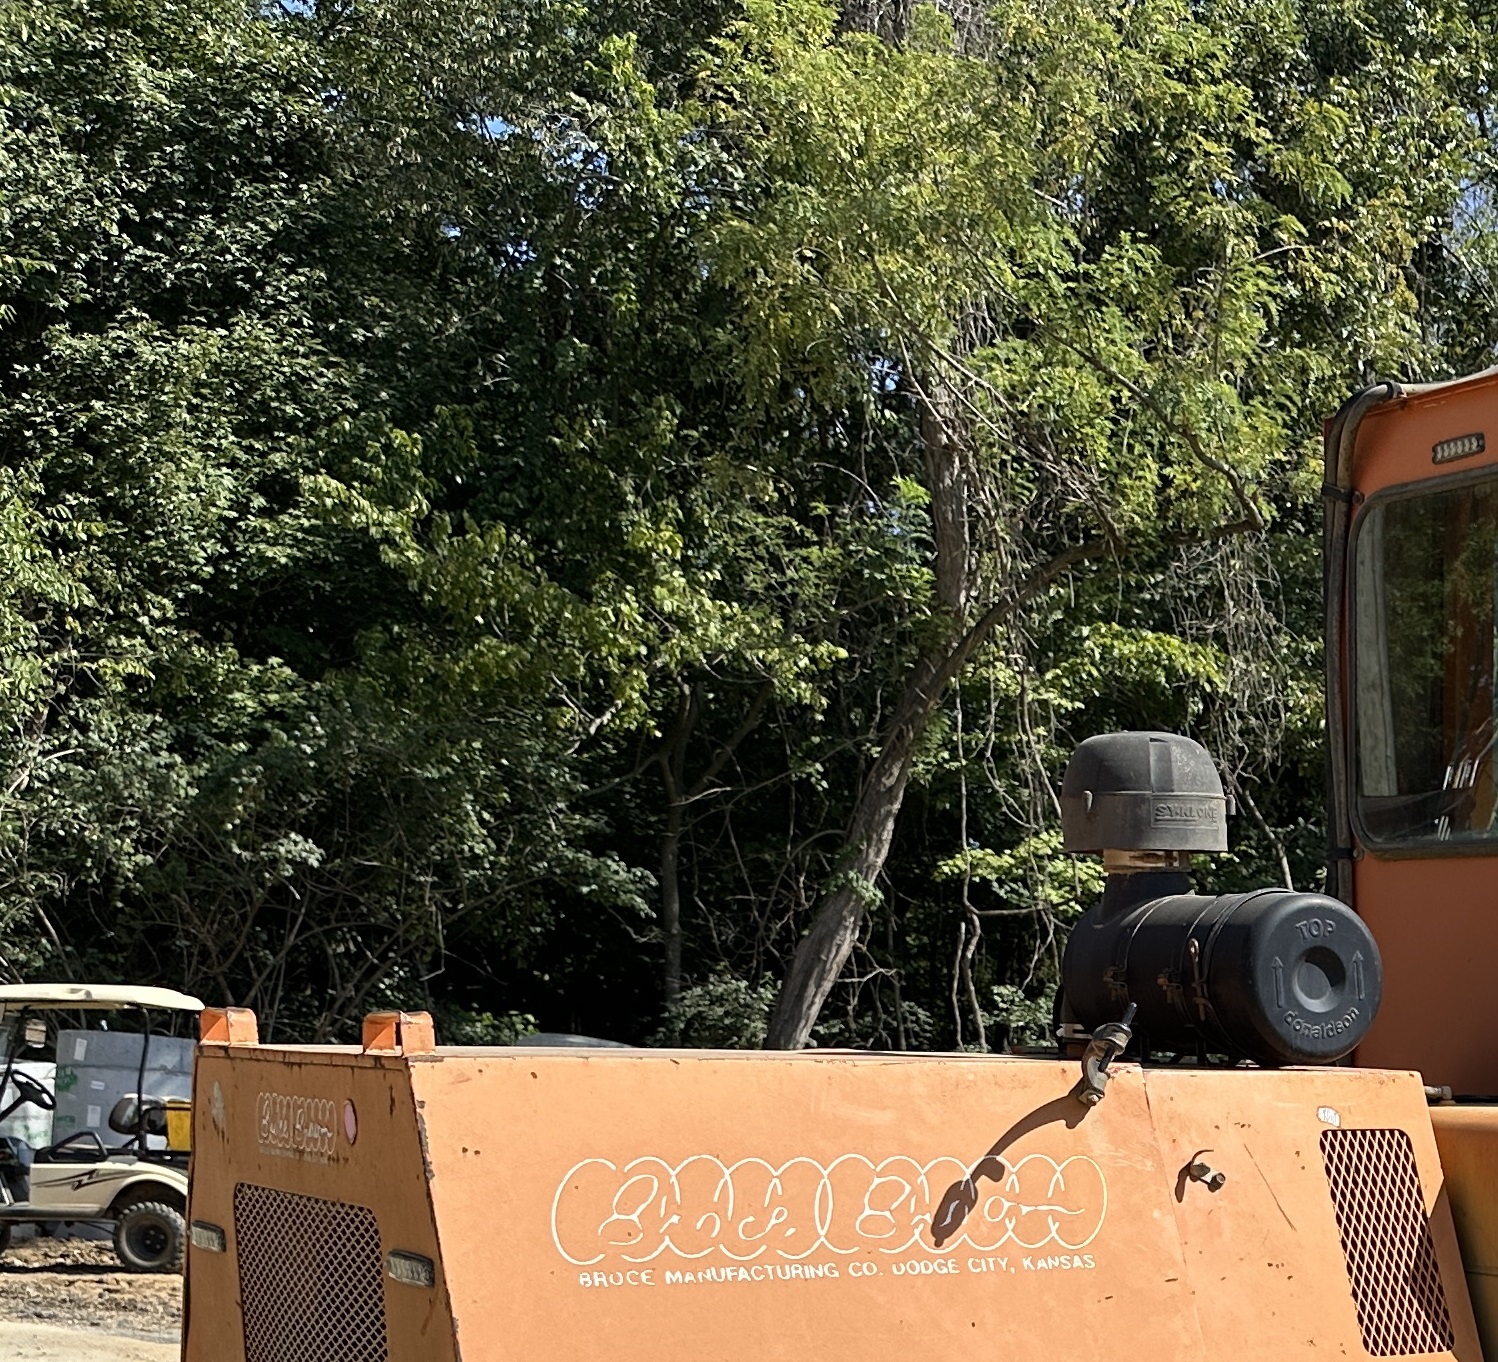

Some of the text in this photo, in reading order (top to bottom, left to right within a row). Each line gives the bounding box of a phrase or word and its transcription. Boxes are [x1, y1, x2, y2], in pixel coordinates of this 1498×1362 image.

[1294, 917, 1336, 940] TOP
[664, 1262, 840, 1285] MANUFACTURING
[848, 1261, 884, 1278] CO.
[891, 1258, 961, 1276] DODGE
[967, 1256, 1016, 1275] CITY,
[1022, 1254, 1096, 1271] KANSAS
